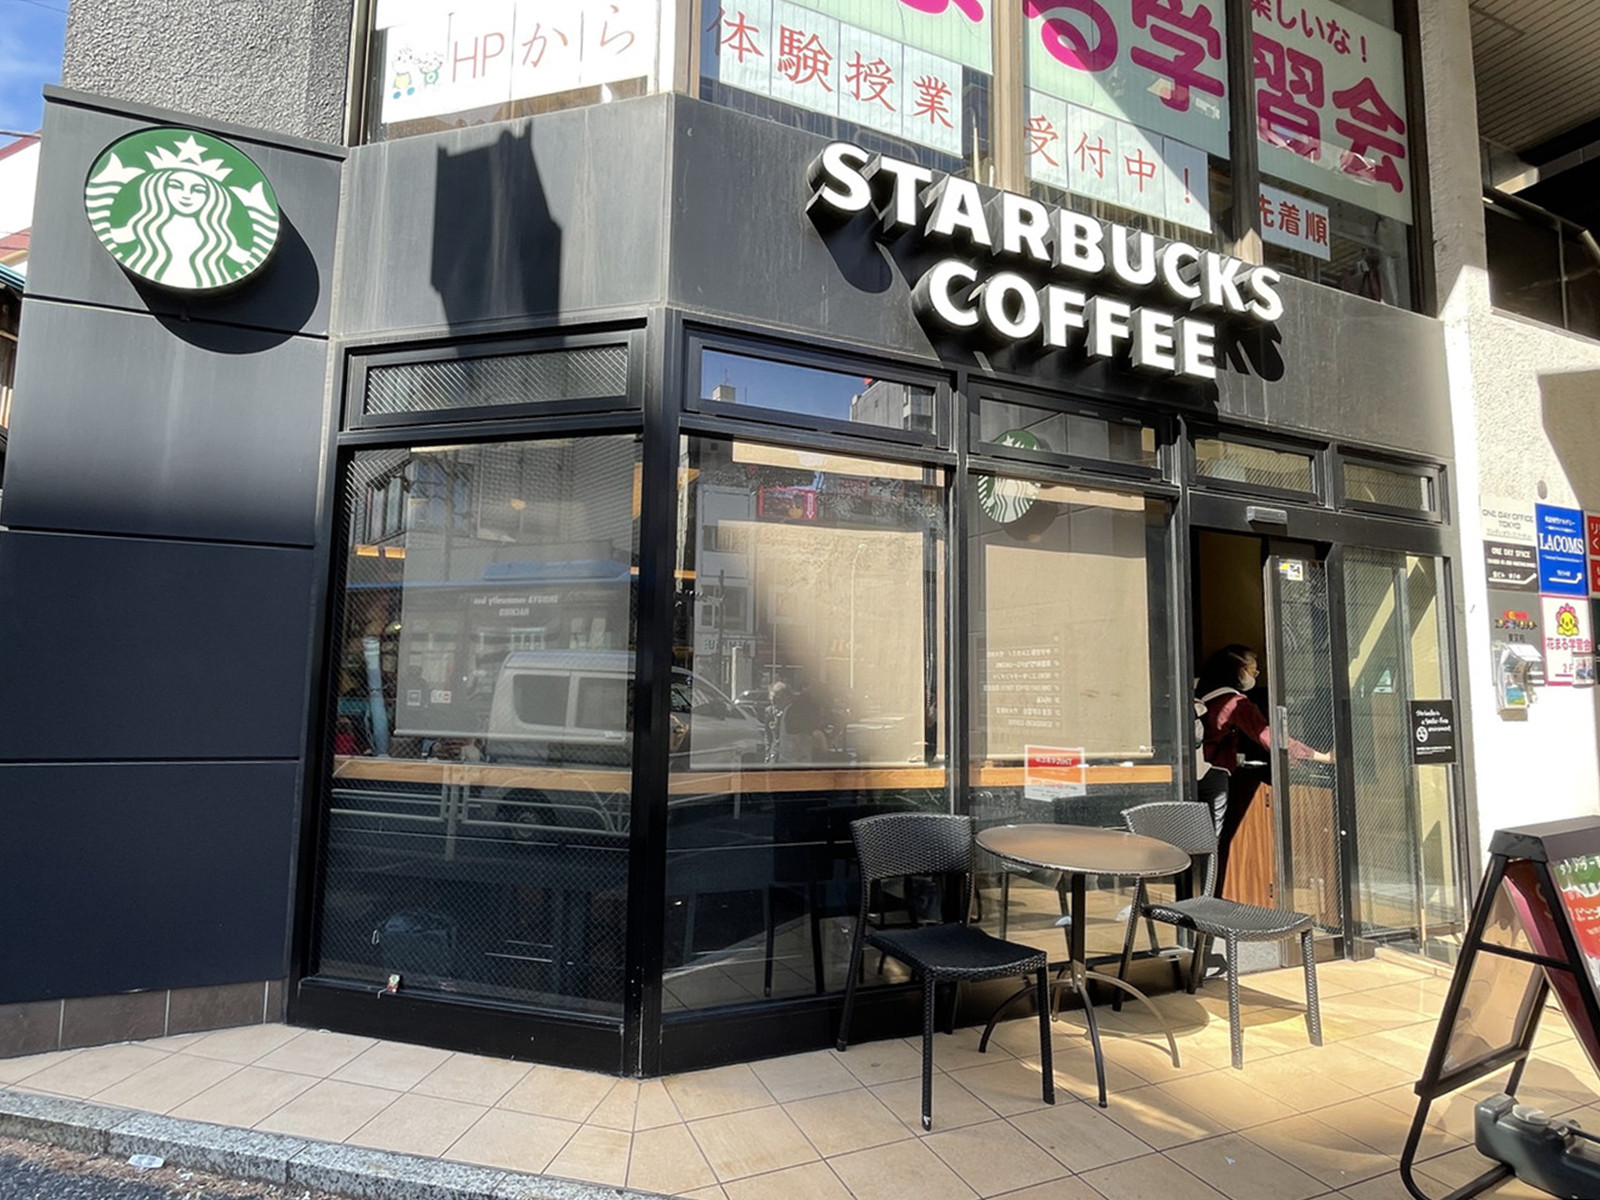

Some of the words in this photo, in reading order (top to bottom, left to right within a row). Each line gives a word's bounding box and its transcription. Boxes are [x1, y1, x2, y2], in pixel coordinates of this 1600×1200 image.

[451, 4, 636, 83] HPから
[706, 10, 954, 129] 体験授業
[808, 139, 1284, 322] STARBUCKS
[1259, 194, 1328, 247] 先着順
[918, 258, 1217, 380] COFFEE
[1539, 532, 1584, 555] LACOMS
